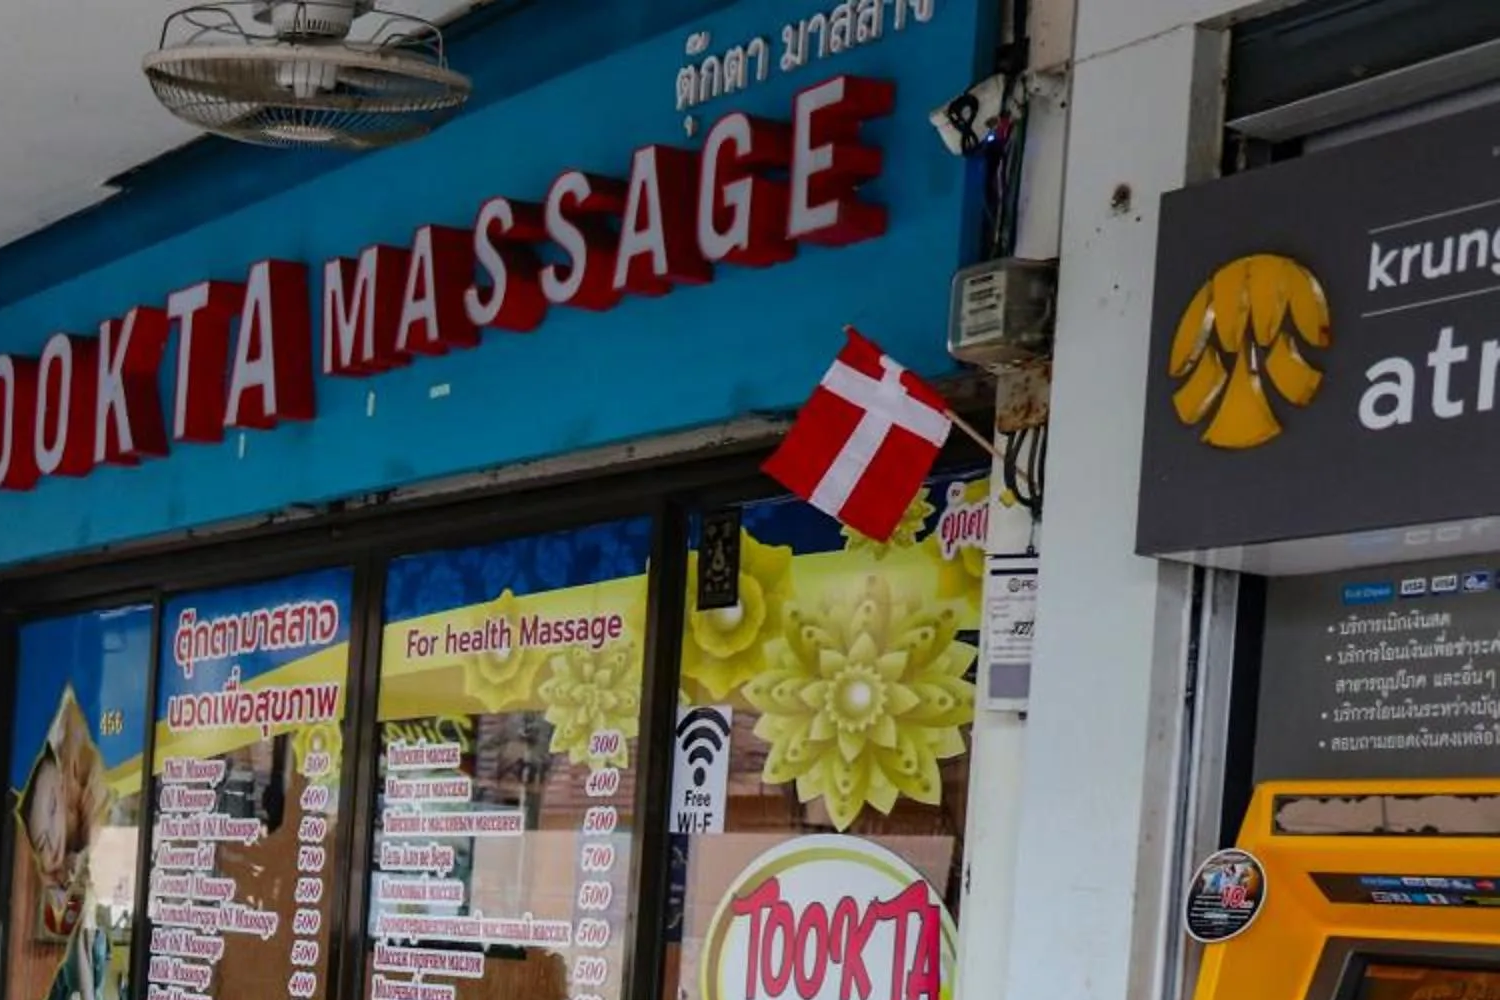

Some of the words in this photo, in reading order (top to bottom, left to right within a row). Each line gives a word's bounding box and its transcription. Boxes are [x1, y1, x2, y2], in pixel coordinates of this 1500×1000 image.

[320, 75, 885, 378] MASSAGE
[1367, 227, 1500, 292] krun
[407, 629, 438, 658] For
[445, 618, 511, 653] health
[519, 614, 622, 649] Massage
[590, 734, 619, 753] 300
[588, 772, 616, 793] 400
[684, 789, 711, 807] Free
[585, 811, 613, 831] 500
[299, 849, 323, 869] 700
[584, 846, 612, 867] 700
[296, 880, 321, 900] 500
[580, 885, 609, 906] 500
[294, 911, 319, 932] 500
[578, 921, 607, 942] 500
[292, 942, 318, 963] 500
[575, 959, 604, 981] 500
[289, 973, 315, 995] 400
